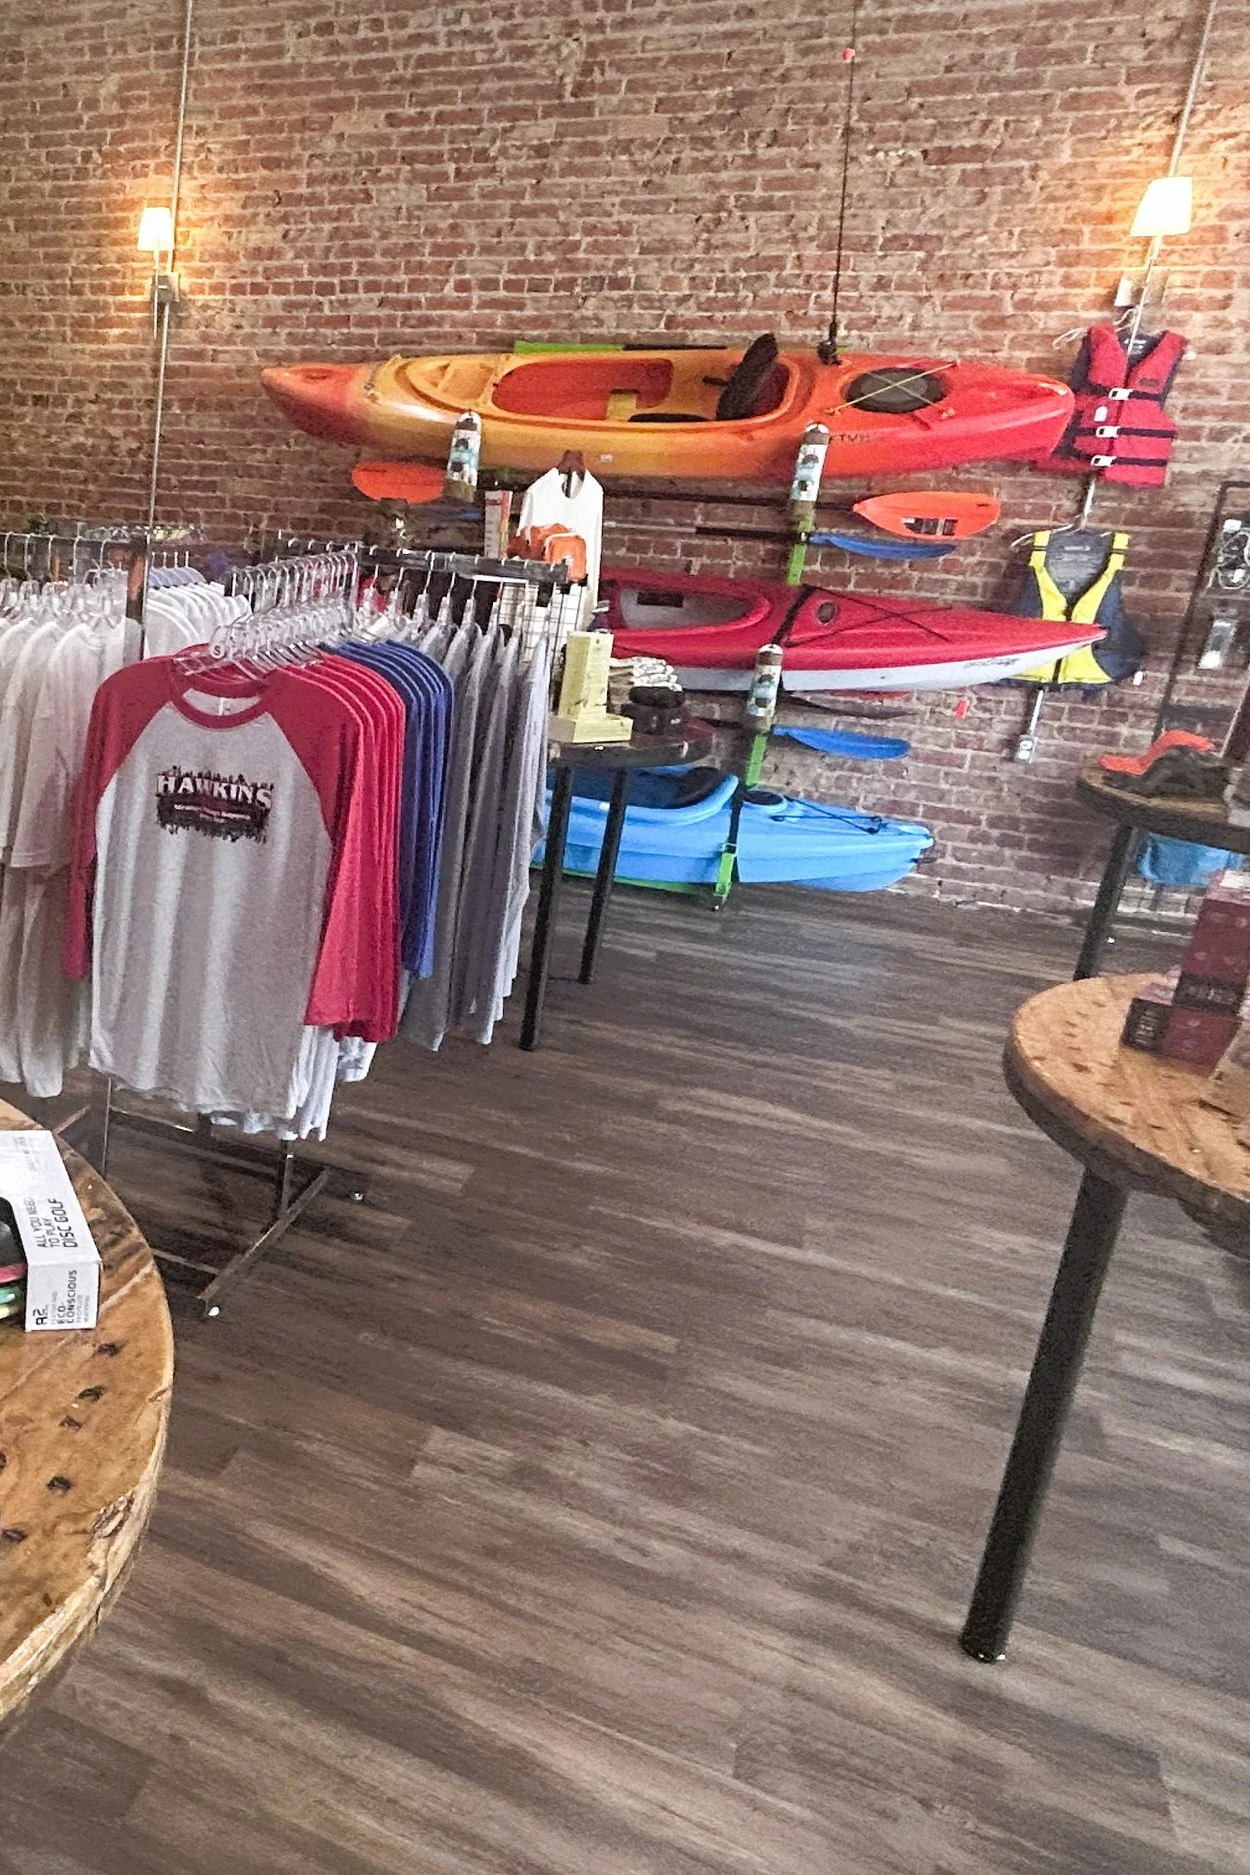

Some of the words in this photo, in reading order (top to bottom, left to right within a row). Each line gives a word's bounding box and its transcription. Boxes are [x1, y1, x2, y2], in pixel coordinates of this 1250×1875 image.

[157, 774, 273, 810] HAWKINS
[51, 1198, 69, 1223] GOLF
[29, 1216, 43, 1234] YOU
[44, 1218, 58, 1236] PLAY
[34, 1233, 49, 1249] ALL
[48, 1236, 60, 1249] TO
[61, 1223, 79, 1249] DISC
[66, 1269, 79, 1324] CONSCIOUS
